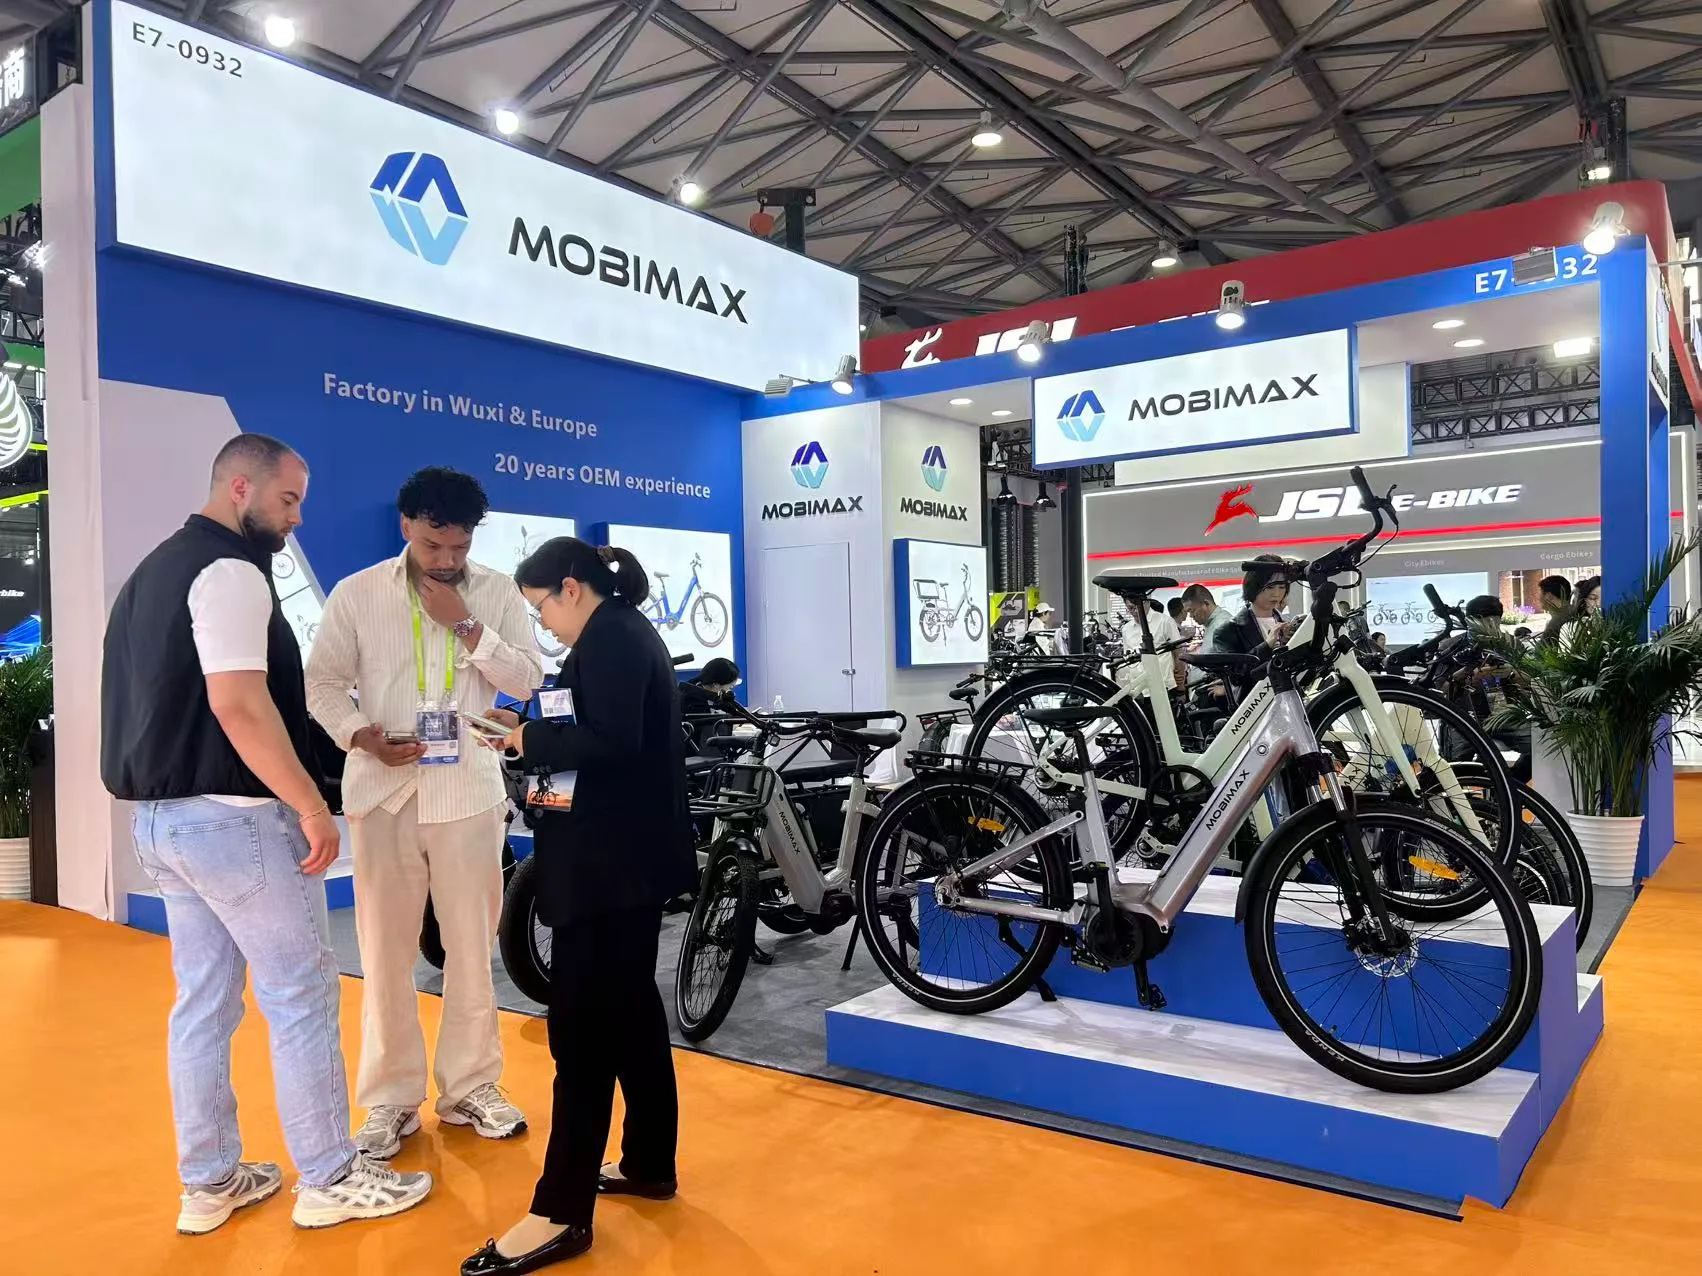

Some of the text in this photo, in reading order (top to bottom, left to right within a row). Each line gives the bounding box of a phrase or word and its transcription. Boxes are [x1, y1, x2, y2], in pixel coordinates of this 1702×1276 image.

[132, 21, 242, 78] E7-0932
[508, 216, 748, 324] MOBIMAX
[323, 372, 598, 438] Factory in Wuxi & Europe
[1128, 373, 1319, 421] MOBIMAX
[494, 453, 711, 499] 20 years OEM experience
[1391, 484, 1523, 512] E-BIKE
[762, 495, 863, 521] MOBIMAX
[900, 497, 968, 522] MOBIMAX
[1231, 682, 1273, 735] MOBIMAX
[1206, 768, 1250, 831] MOBIMAX
[779, 811, 801, 855] MOBIMAX
